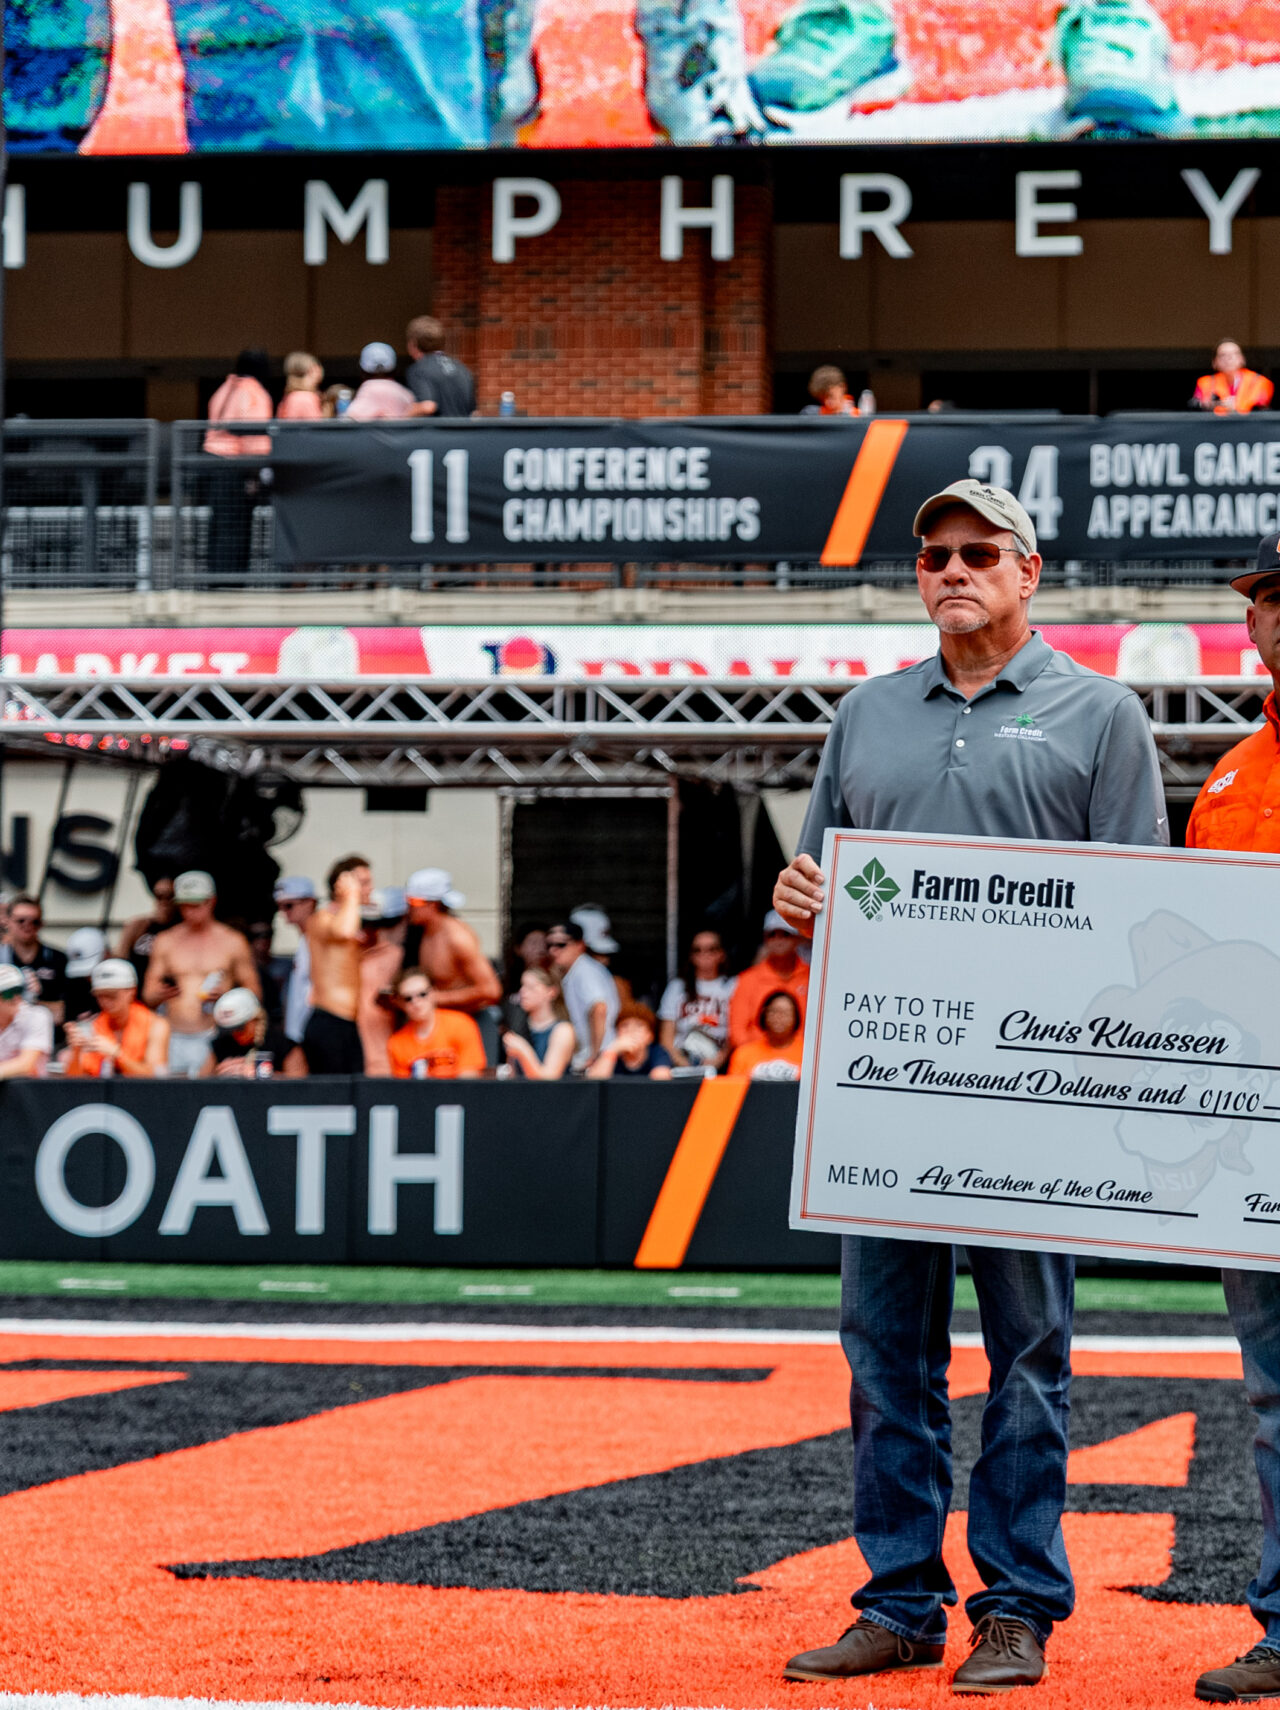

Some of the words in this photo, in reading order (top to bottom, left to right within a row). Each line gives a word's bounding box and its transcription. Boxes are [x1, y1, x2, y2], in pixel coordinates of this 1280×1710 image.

[503, 447, 711, 491] CONFERENCE
[1090, 443, 1181, 487] BOWL
[407, 449, 469, 544] 11
[503, 498, 761, 542] CHAMPIONSHIPS
[1000, 725, 1019, 735] Farm
[1019, 727, 1043, 738] Credit
[912, 869, 980, 902] Farm
[987, 873, 1076, 909] Credit
[890, 902, 977, 923] WESTERN
[982, 909, 1094, 931] OKLAHOMA
[844, 993, 887, 1014] PAY
[894, 996, 925, 1017] TO
[933, 999, 975, 1021] THE
[848, 1019, 926, 1043] ORDER
[937, 1026, 967, 1046] OF
[999, 1009, 1083, 1045] Chris
[1087, 1016, 1230, 1056] Klaassen
[847, 1054, 899, 1082] One
[902, 1059, 1023, 1093] Thousand
[1026, 1069, 1131, 1102] Dollars
[1137, 1084, 1187, 1105] and
[1199, 1088, 1261, 1114] 0/100
[34, 1102, 465, 1238] OATH
[827, 1164, 899, 1188] MEMO
[916, 1165, 955, 1191] Ag
[957, 1168, 1036, 1193] Teacher
[1039, 1178, 1063, 1198] of
[1063, 1177, 1094, 1199] the
[1095, 1180, 1154, 1204] Game
